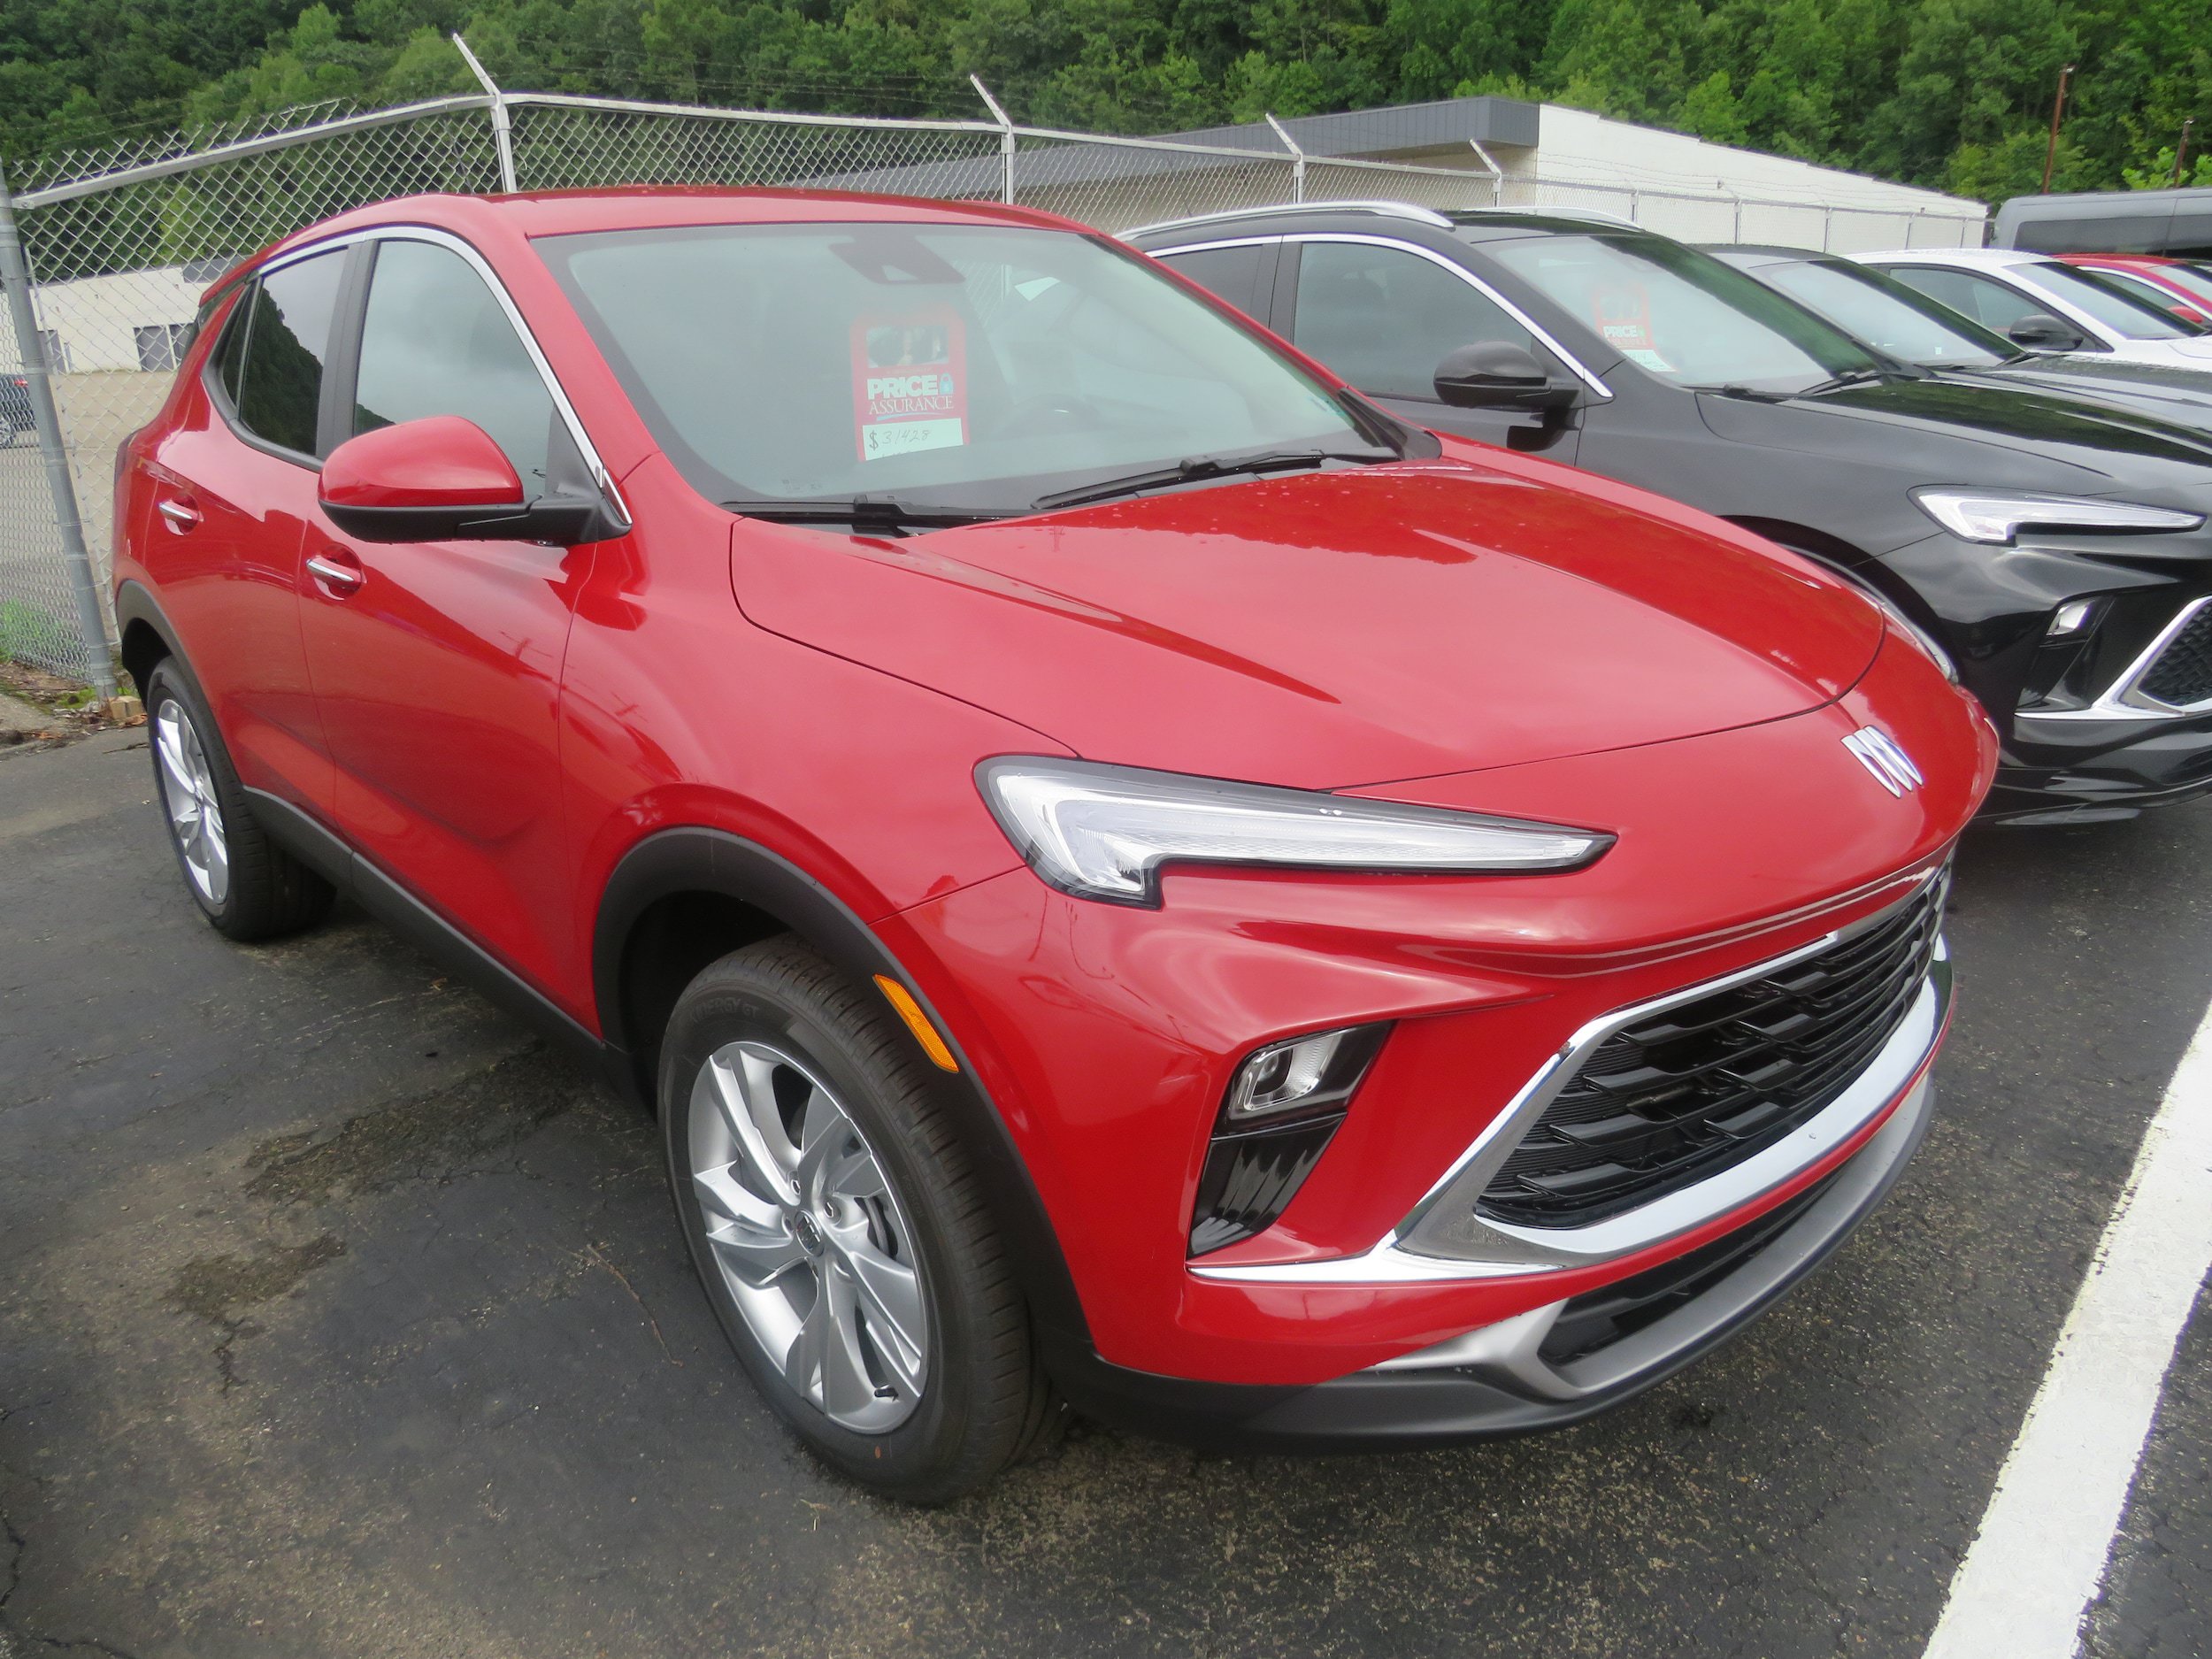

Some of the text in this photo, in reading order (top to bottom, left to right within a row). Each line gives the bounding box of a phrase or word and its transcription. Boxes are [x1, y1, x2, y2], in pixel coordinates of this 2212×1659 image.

[1603, 326, 1638, 337] PRICE
[866, 374, 939, 400] PRICE
[868, 395, 955, 415] ASSURANCE
